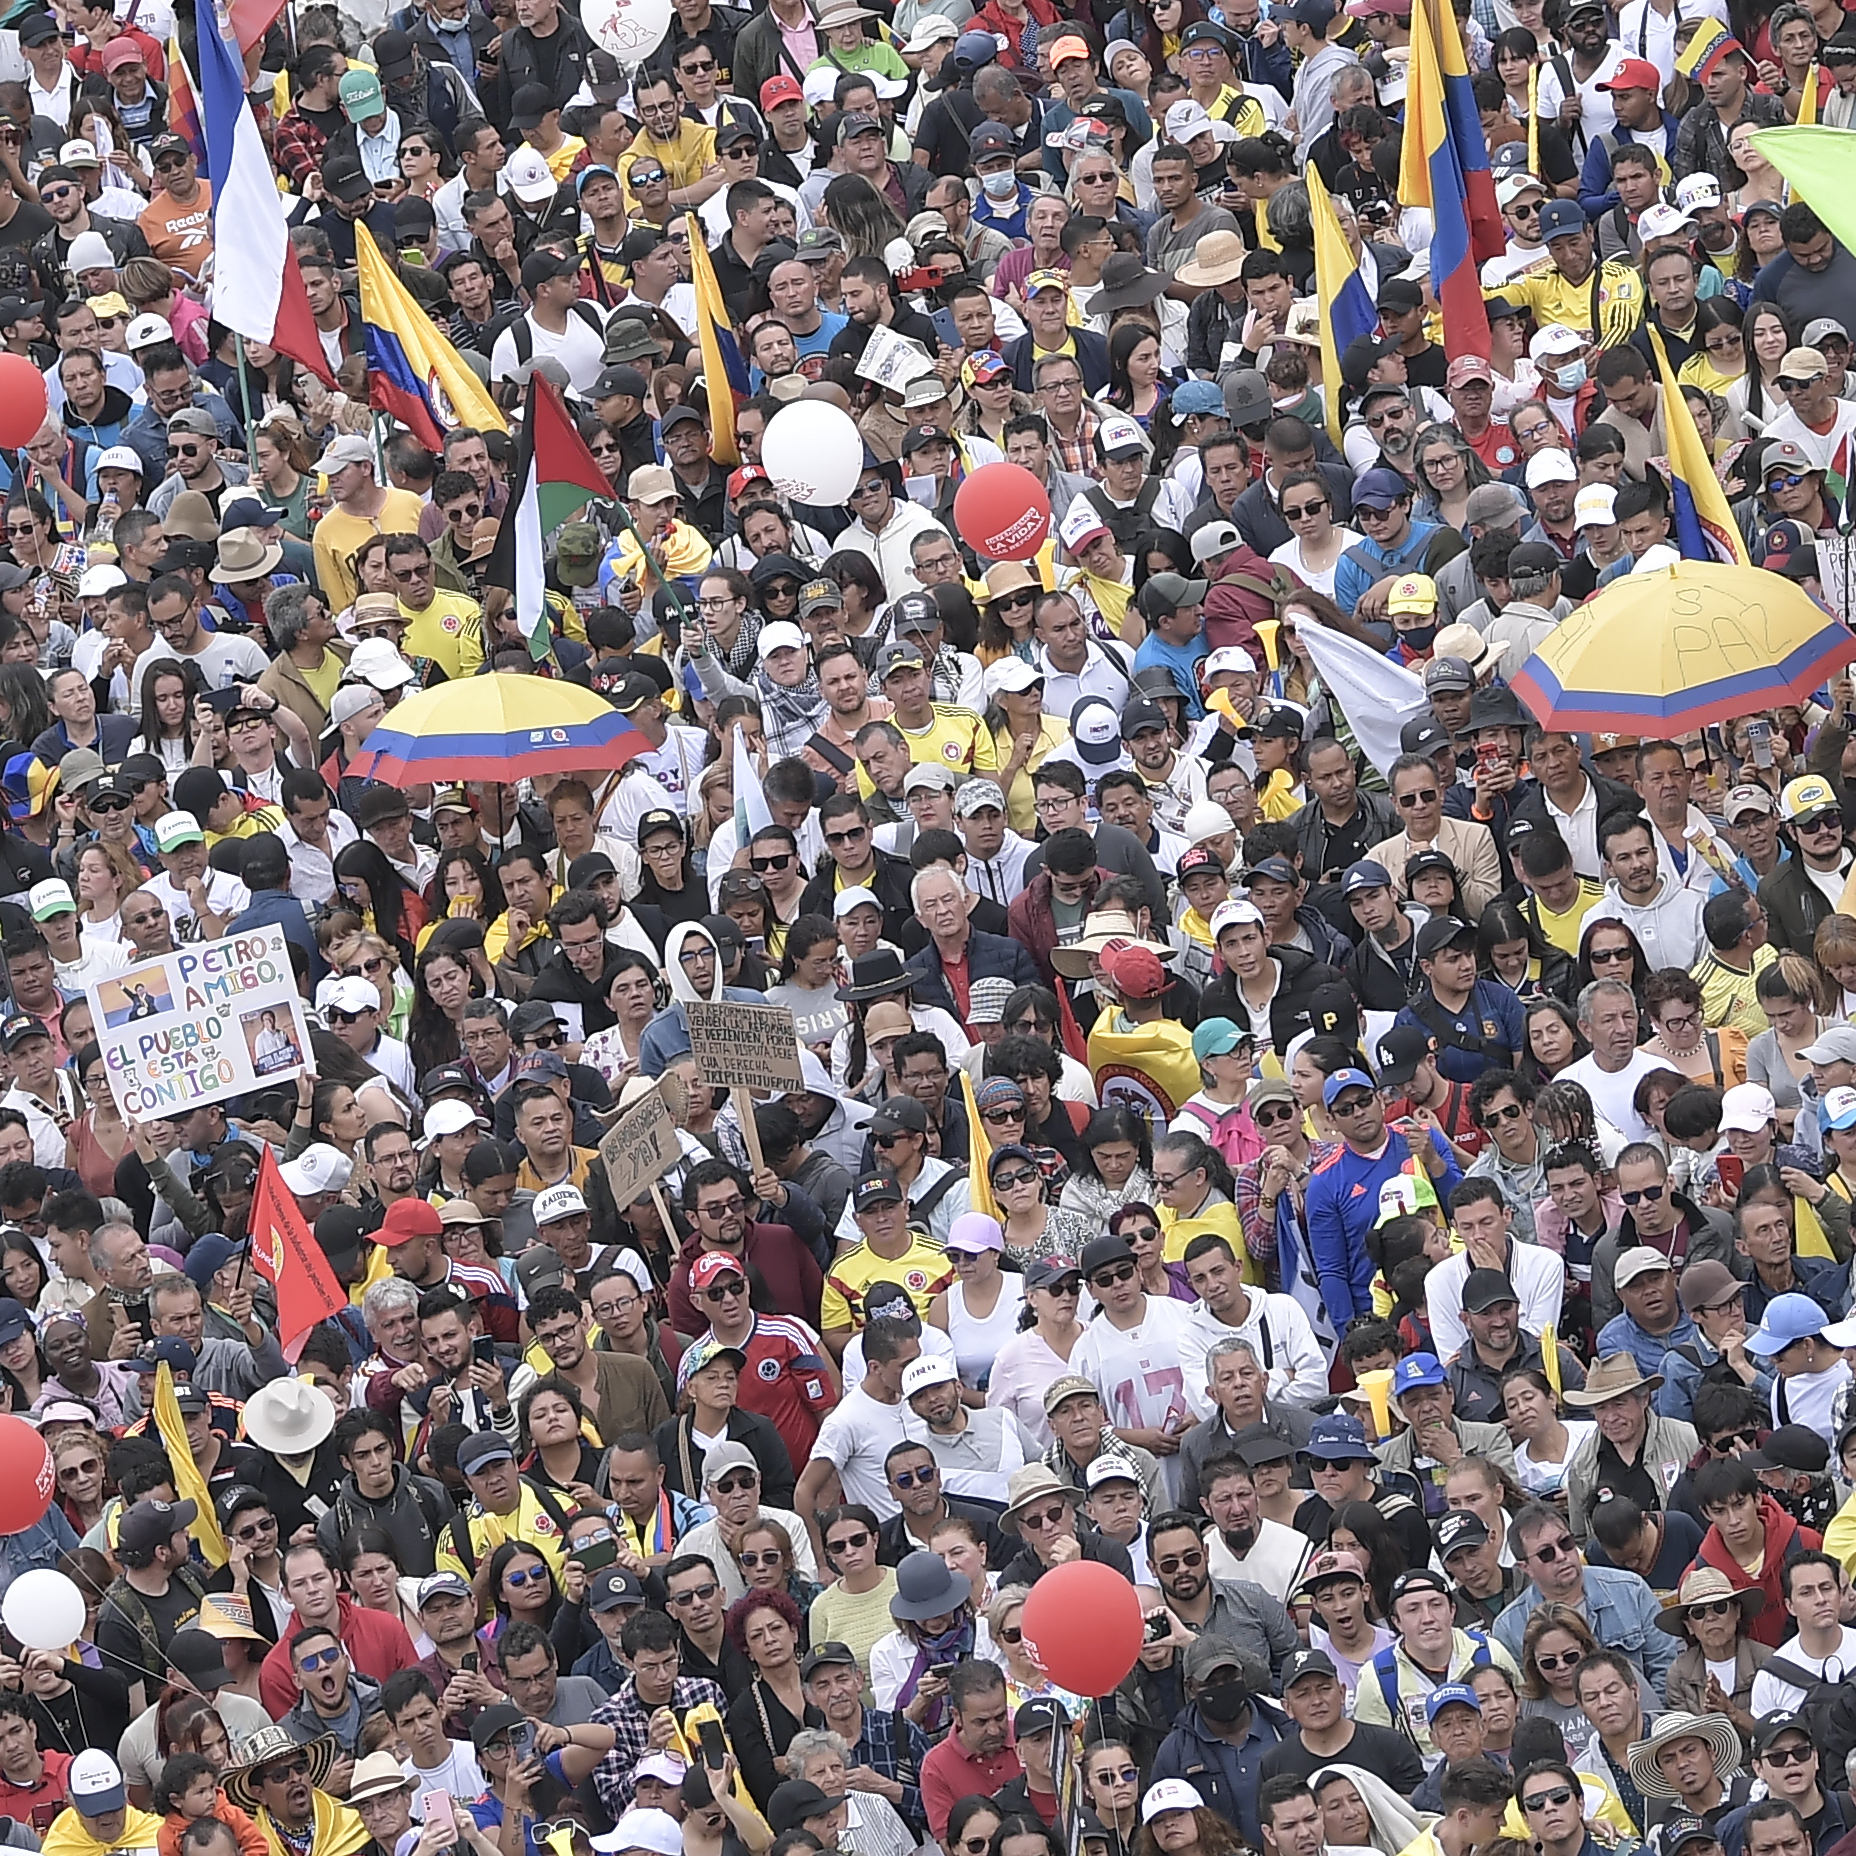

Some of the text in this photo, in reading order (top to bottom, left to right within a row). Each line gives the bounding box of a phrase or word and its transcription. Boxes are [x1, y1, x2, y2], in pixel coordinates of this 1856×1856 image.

[989, 542, 1006, 552] LA
[1006, 521, 1036, 543] VIDA
[1010, 516, 1045, 551] REFORMAS
[178, 936, 268, 983] PETRO
[185, 960, 284, 1012] AMIGO,
[687, 1004, 704, 1016] LAS
[705, 1004, 749, 1023] REFORMAS
[770, 1011, 785, 1026] SE
[727, 1018, 744, 1030] LAS
[748, 1020, 793, 1036] REFORMAS
[106, 1045, 135, 1071] EL
[138, 1016, 222, 1060] PUEBLO
[691, 1028, 703, 1041] SE
[695, 1041, 709, 1054] EN
[711, 1044, 732, 1056] ESTA
[147, 1047, 199, 1078] ESTÁ
[123, 1058, 234, 1115] CONTIGO
[605, 1097, 665, 1165] REFORMAS
[627, 1132, 662, 1175] YA!
